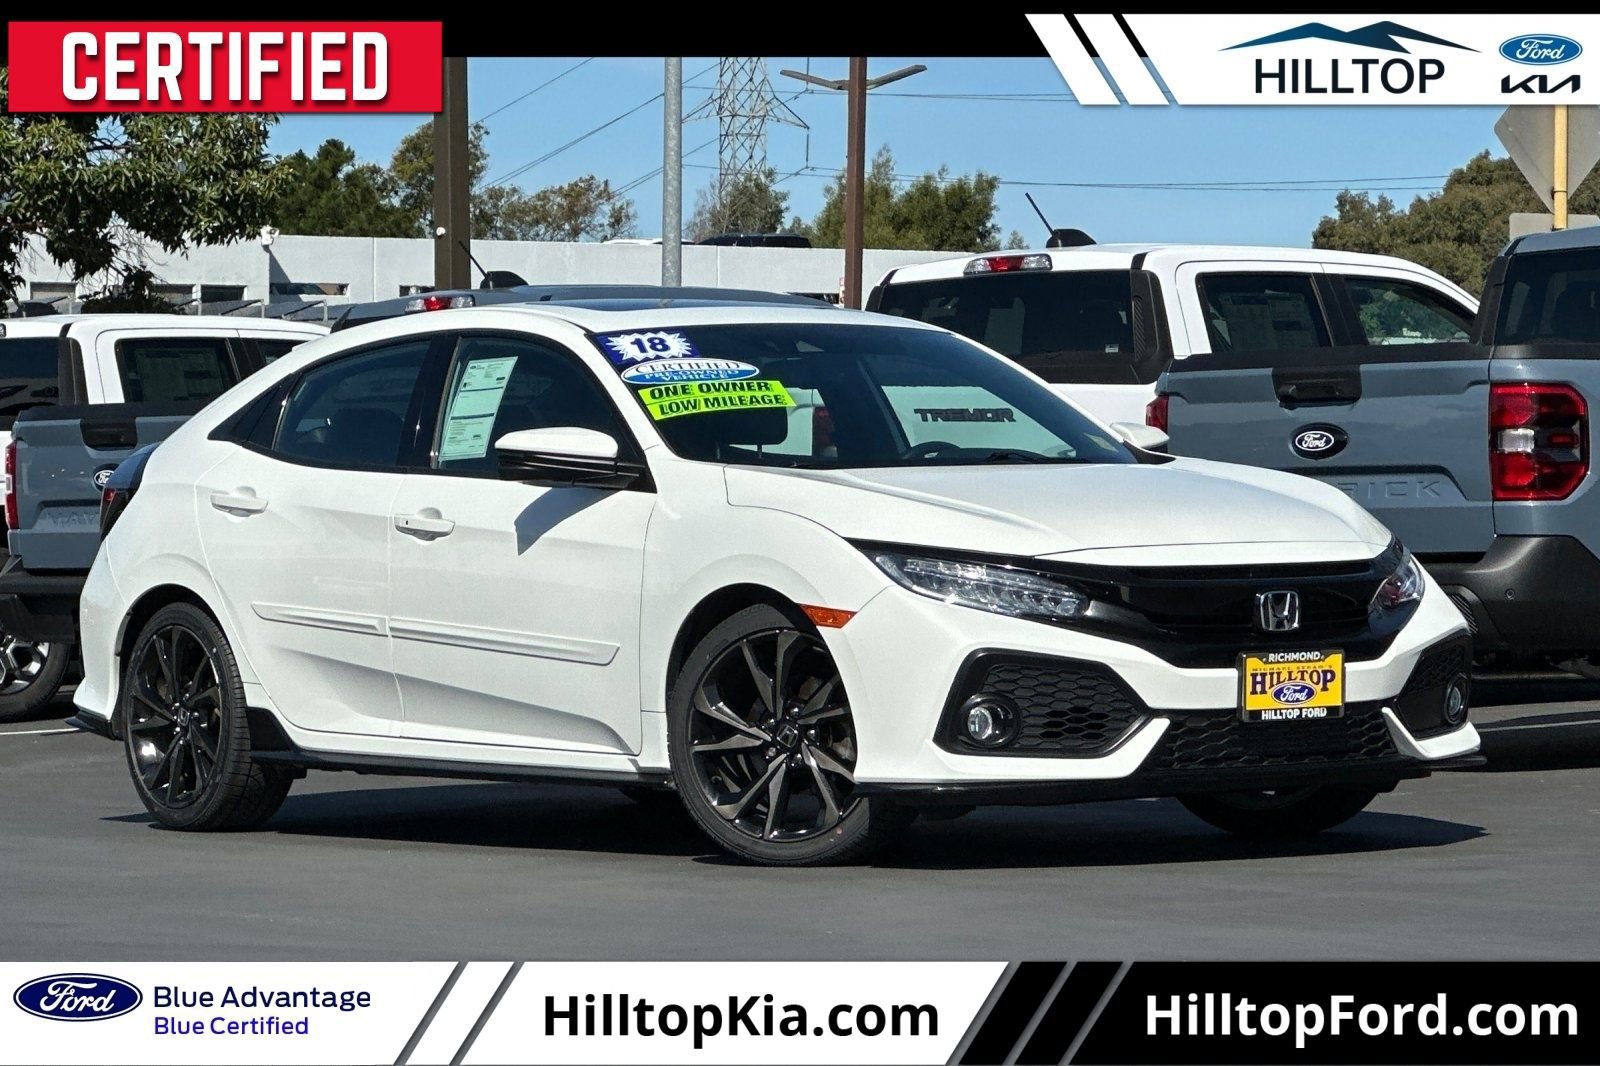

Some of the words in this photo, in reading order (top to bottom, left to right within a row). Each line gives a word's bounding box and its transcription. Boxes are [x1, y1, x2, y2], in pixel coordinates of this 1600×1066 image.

[630, 336, 671, 354] 18
[635, 361, 741, 374] CERTIFIED
[650, 383, 693, 400] ONE
[698, 381, 771, 394] OWNER
[659, 397, 700, 416] LOW
[704, 393, 787, 409] MILEAGE
[913, 407, 1016, 423] TREMOR
[1301, 433, 1327, 448] Ford
[1268, 651, 1321, 663] RICHMOND
[1250, 669, 1336, 695] HILLTOP
[1280, 685, 1308, 702] Ford
[1261, 708, 1301, 720] HILLTOP
[1302, 707, 1327, 719] FORD
